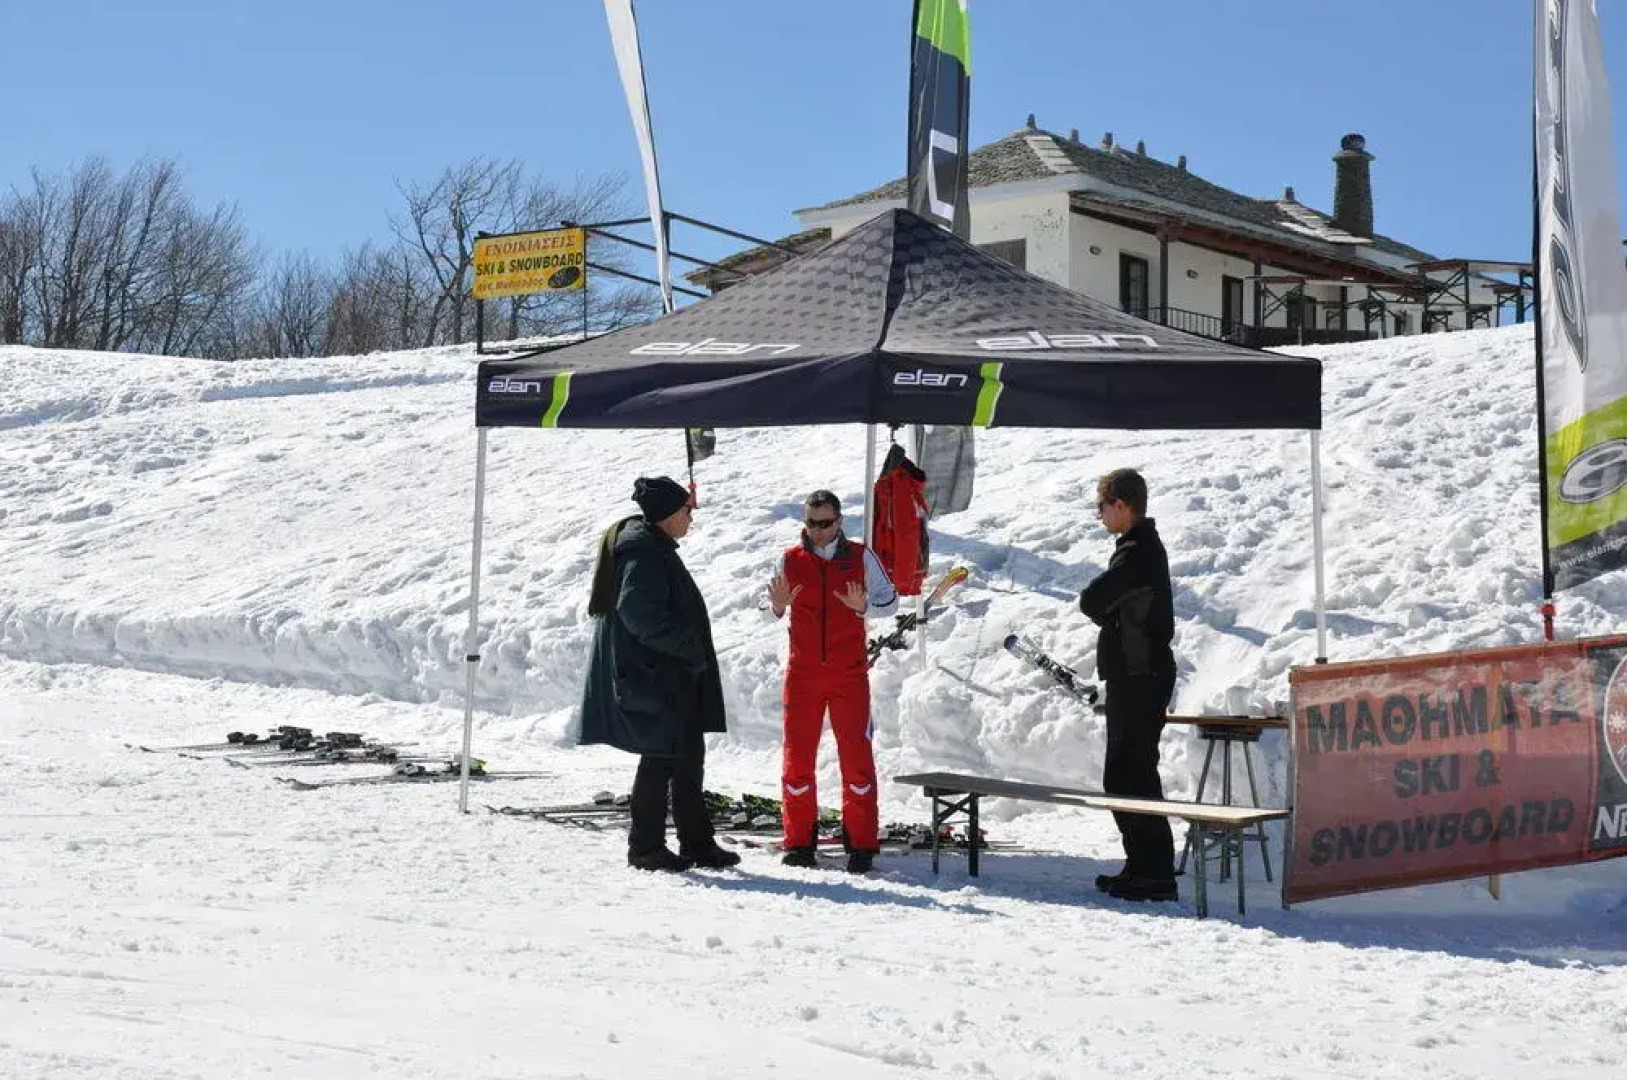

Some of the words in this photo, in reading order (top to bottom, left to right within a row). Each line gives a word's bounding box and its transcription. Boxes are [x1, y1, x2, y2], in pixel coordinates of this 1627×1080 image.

[477, 262, 494, 276] SKI
[498, 260, 505, 273] &
[509, 252, 583, 272] SNOWBOARD
[629, 337, 802, 355] elan
[976, 331, 1158, 350] elan
[488, 377, 541, 393] elan
[893, 368, 968, 386] elan
[1394, 754, 1460, 798] SKI
[1475, 749, 1500, 788] &
[1309, 797, 1575, 867] SNOWBOARD
